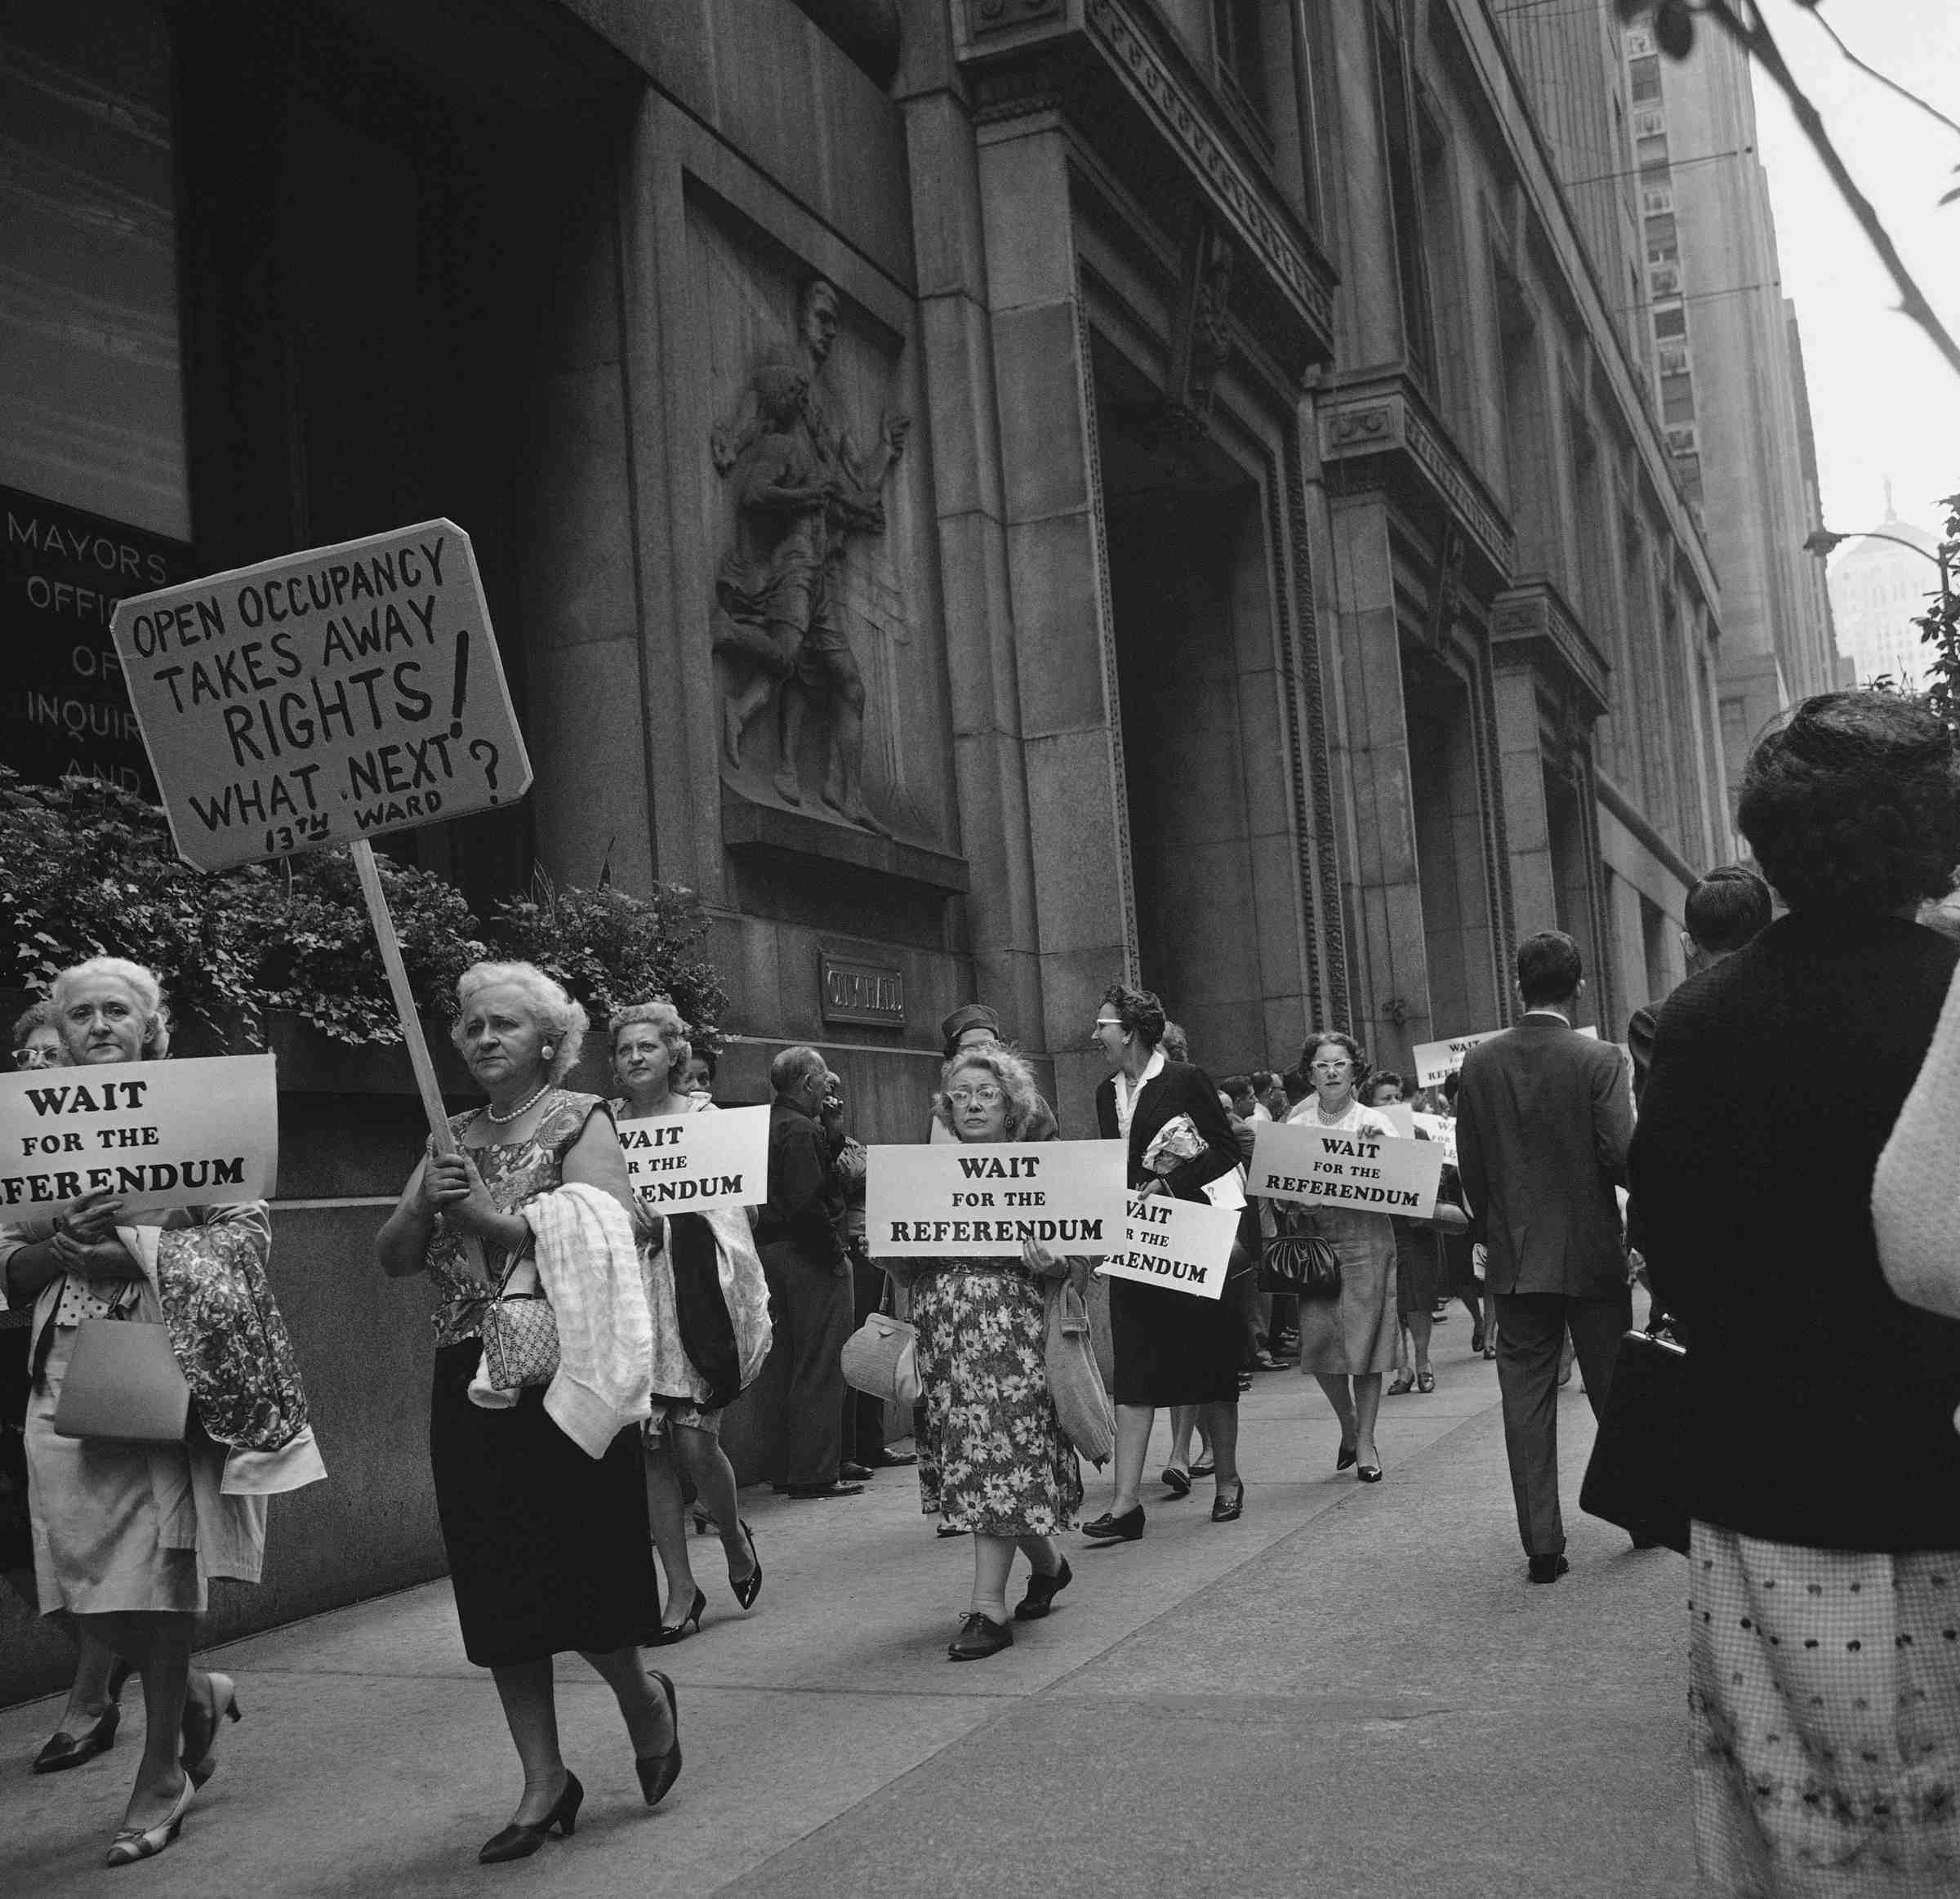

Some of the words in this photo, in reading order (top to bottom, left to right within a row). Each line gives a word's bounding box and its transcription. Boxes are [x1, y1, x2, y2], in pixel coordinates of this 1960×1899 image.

[7, 510, 168, 585] MAYORS
[133, 595, 225, 658] OPEN
[238, 537, 444, 627] OCCUPANCY
[154, 632, 303, 713] TAKES
[323, 595, 436, 666] AWAY
[189, 763, 320, 831] WHAT
[354, 790, 442, 831] WARD
[24, 1081, 148, 1117] WAIT
[21, 1133, 85, 1157] FOR
[97, 1126, 160, 1150] THE
[1321, 1138, 1381, 1160] WAIT
[648, 1155, 688, 1172] THE
[957, 1157, 1040, 1179] WAIT
[1312, 1161, 1343, 1175] FOR
[1350, 1165, 1381, 1179] THE
[0, 1157, 245, 1206] FERENDUM
[631, 1174, 743, 1203] ENDUM
[1266, 1175, 1420, 1207] REFERENDUM
[951, 1192, 1000, 1208] FOR
[1004, 1191, 1046, 1207] THE
[890, 1219, 1104, 1242] REFERENDUM
[1140, 1231, 1169, 1247] THE
